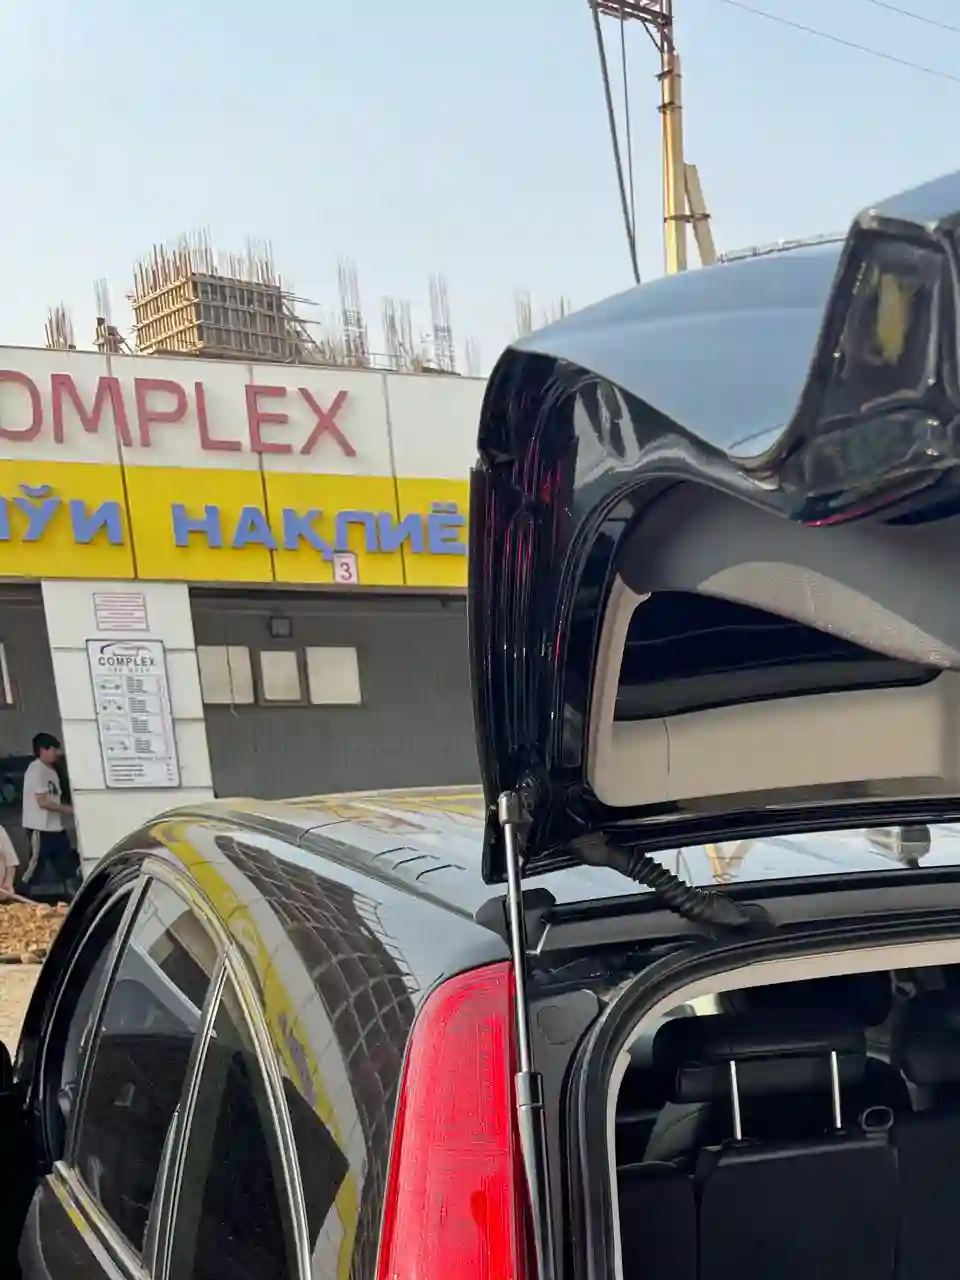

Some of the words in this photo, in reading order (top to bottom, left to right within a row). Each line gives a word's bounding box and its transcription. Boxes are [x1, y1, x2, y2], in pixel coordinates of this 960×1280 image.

[0, 369, 356, 457] OMPLEX
[340, 562, 353, 581] 3
[98, 656, 156, 667] COMPLEX
